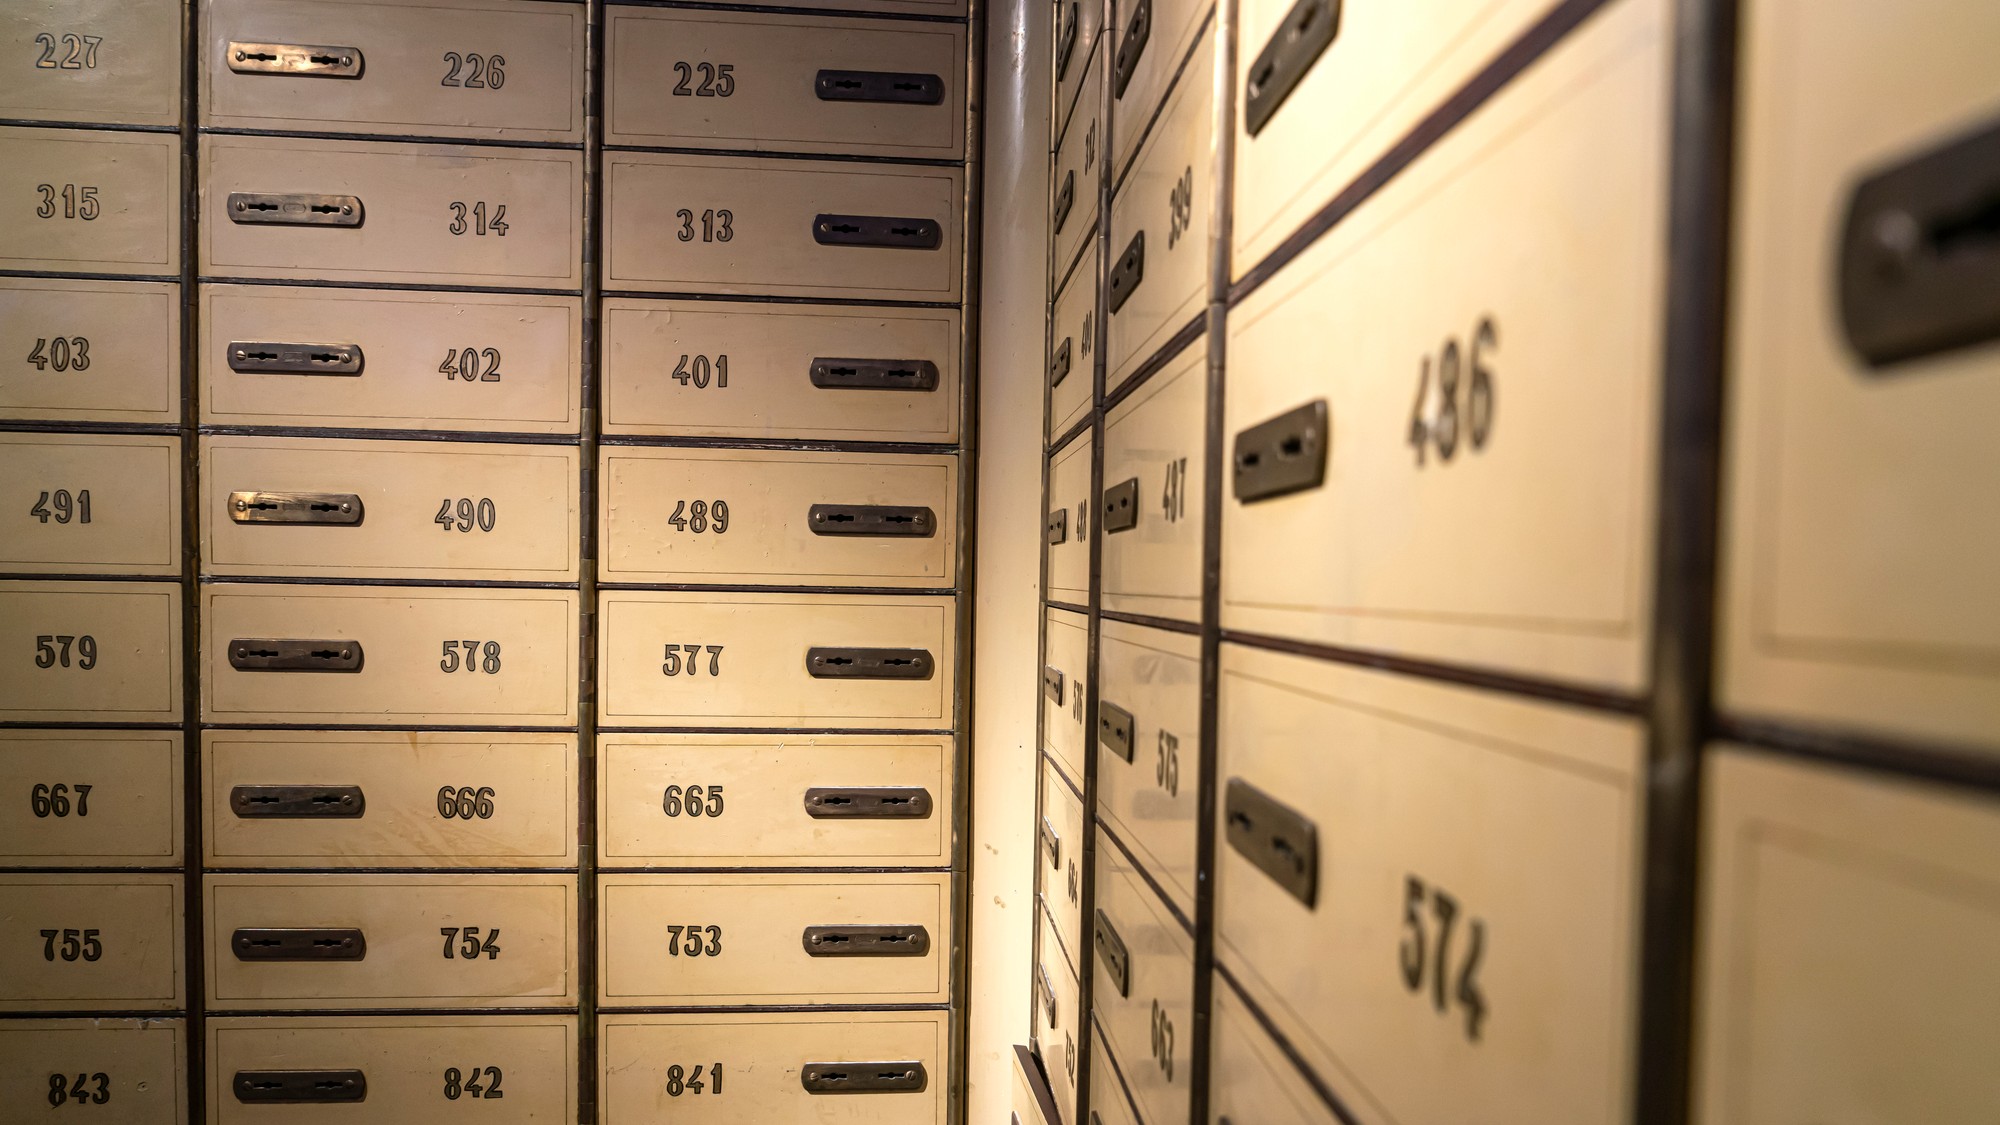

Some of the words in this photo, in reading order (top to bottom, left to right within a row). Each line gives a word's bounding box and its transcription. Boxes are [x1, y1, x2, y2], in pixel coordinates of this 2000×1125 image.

[34, 32, 103, 70] 227
[440, 51, 506, 91] 226
[672, 60, 736, 98] 225
[36, 183, 100, 221] 315
[448, 201, 510, 237] 314
[1168, 165, 1192, 251] 399
[676, 208, 734, 243] 313
[26, 336, 91, 373] 403
[438, 347, 502, 383] 402
[671, 354, 728, 390] 401
[1408, 312, 1500, 469] 486
[29, 488, 92, 525] 491
[1163, 457, 1187, 523] 487
[434, 497, 496, 534] 490
[667, 499, 730, 535] 489
[34, 634, 98, 671] 579
[439, 639, 502, 675] 578
[662, 643, 725, 677] 577
[1073, 679, 1083, 725] 576
[1156, 728, 1179, 798] 575
[30, 782, 93, 819] 667
[436, 785, 496, 821] 666
[662, 784, 725, 818] 665
[1068, 858, 1078, 909] 664
[39, 928, 103, 963] 755
[439, 926, 501, 961] 754
[666, 924, 722, 958] 753
[1400, 873, 1490, 1043] 574
[1065, 1029, 1075, 1089] 752
[1151, 998, 1174, 1083] 663
[47, 1071, 111, 1111] 843
[443, 1065, 504, 1101] 842
[665, 1062, 723, 1098] 841
